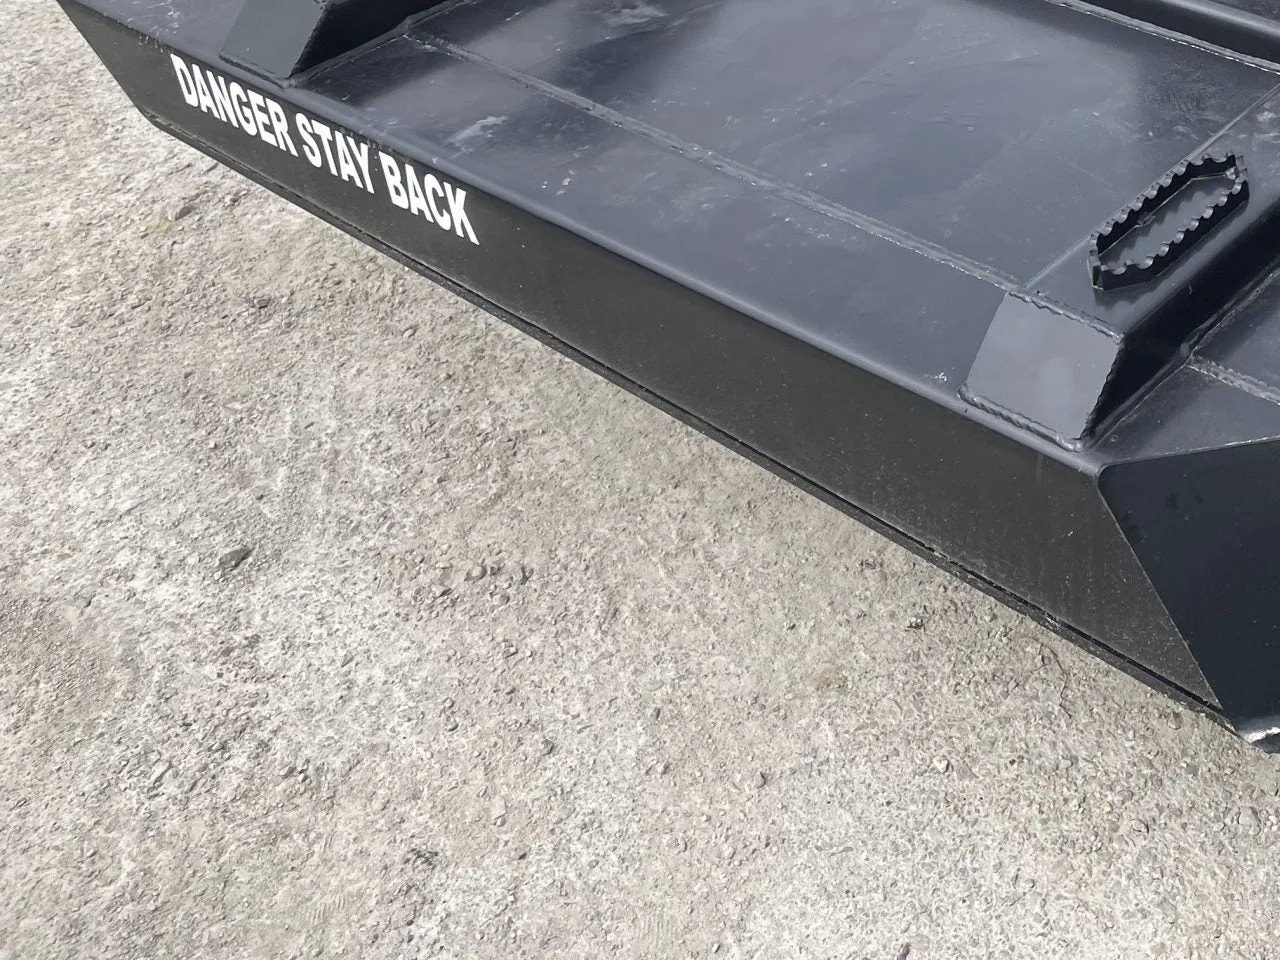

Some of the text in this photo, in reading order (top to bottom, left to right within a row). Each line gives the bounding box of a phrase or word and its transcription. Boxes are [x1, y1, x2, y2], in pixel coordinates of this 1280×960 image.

[170, 53, 480, 246] DANGER STAY BACK
